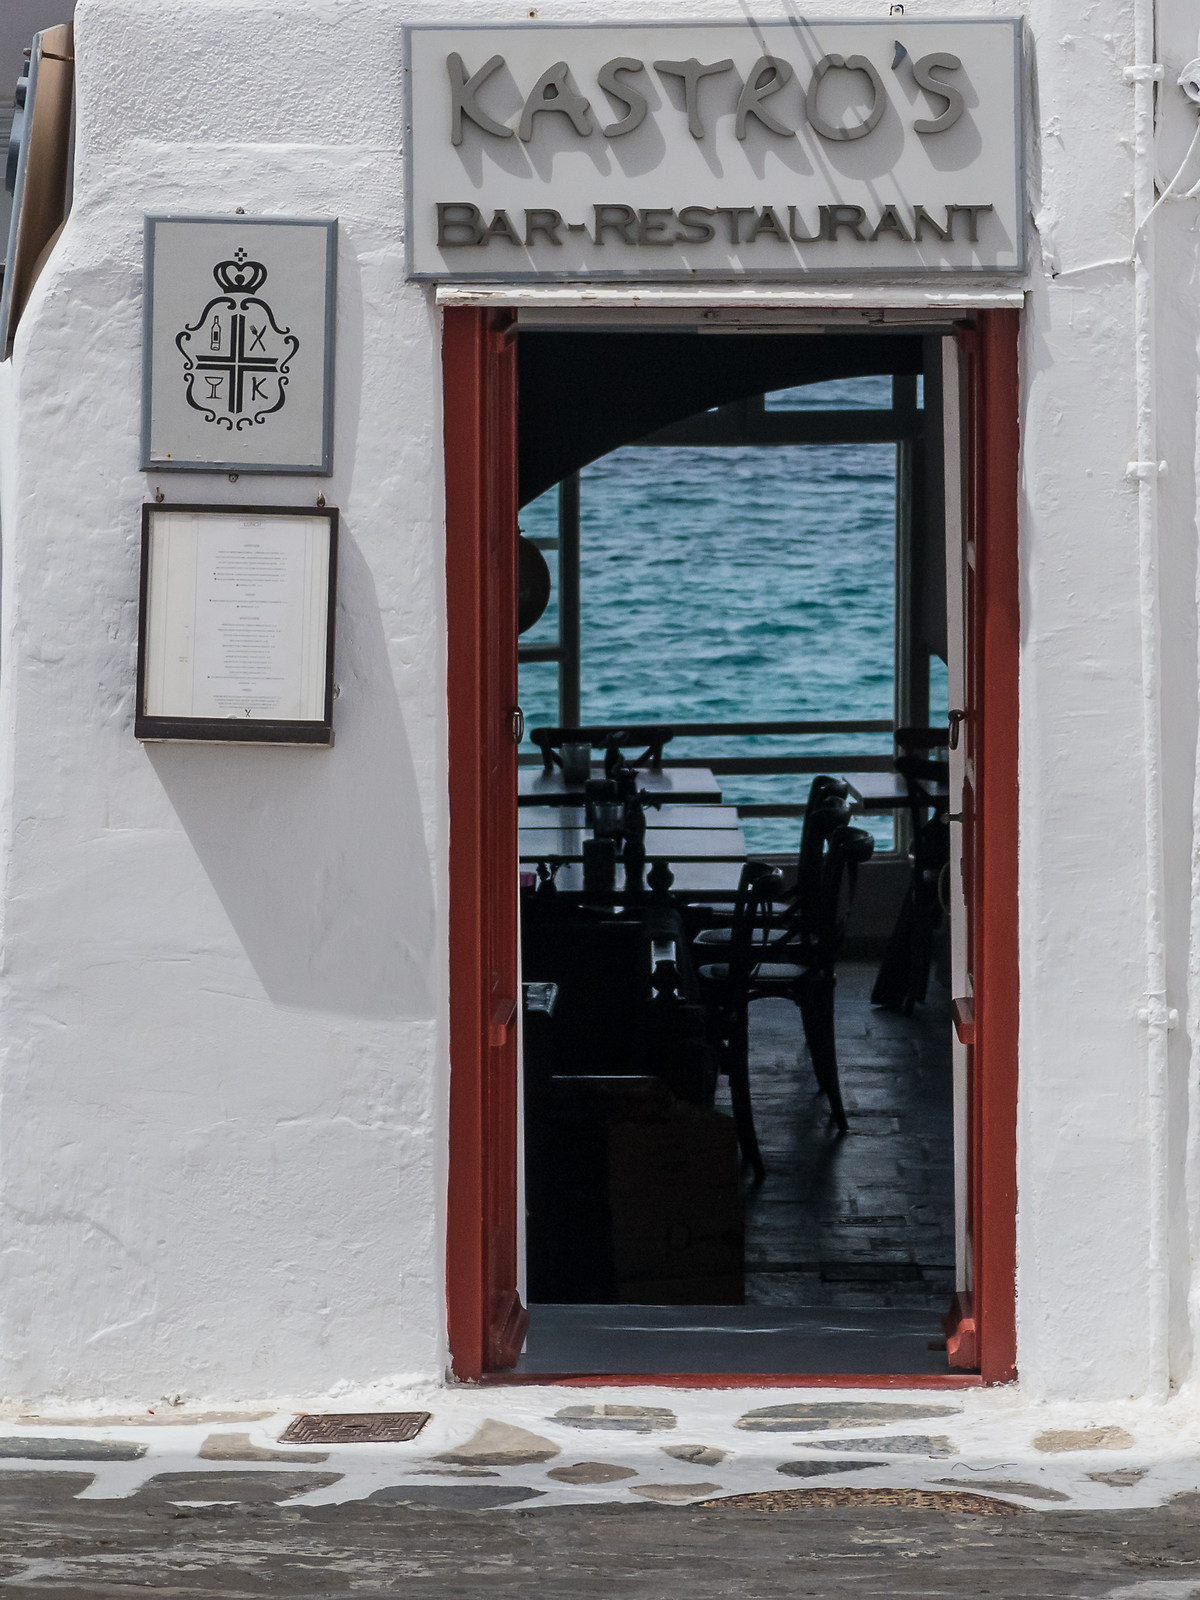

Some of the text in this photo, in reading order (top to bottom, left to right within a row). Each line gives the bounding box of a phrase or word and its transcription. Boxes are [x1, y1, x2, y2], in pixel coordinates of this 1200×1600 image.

[446, 41, 962, 146] KASTRO'S
[435, 201, 993, 247] BAR-RESTAURANT
[252, 377, 268, 401] K
